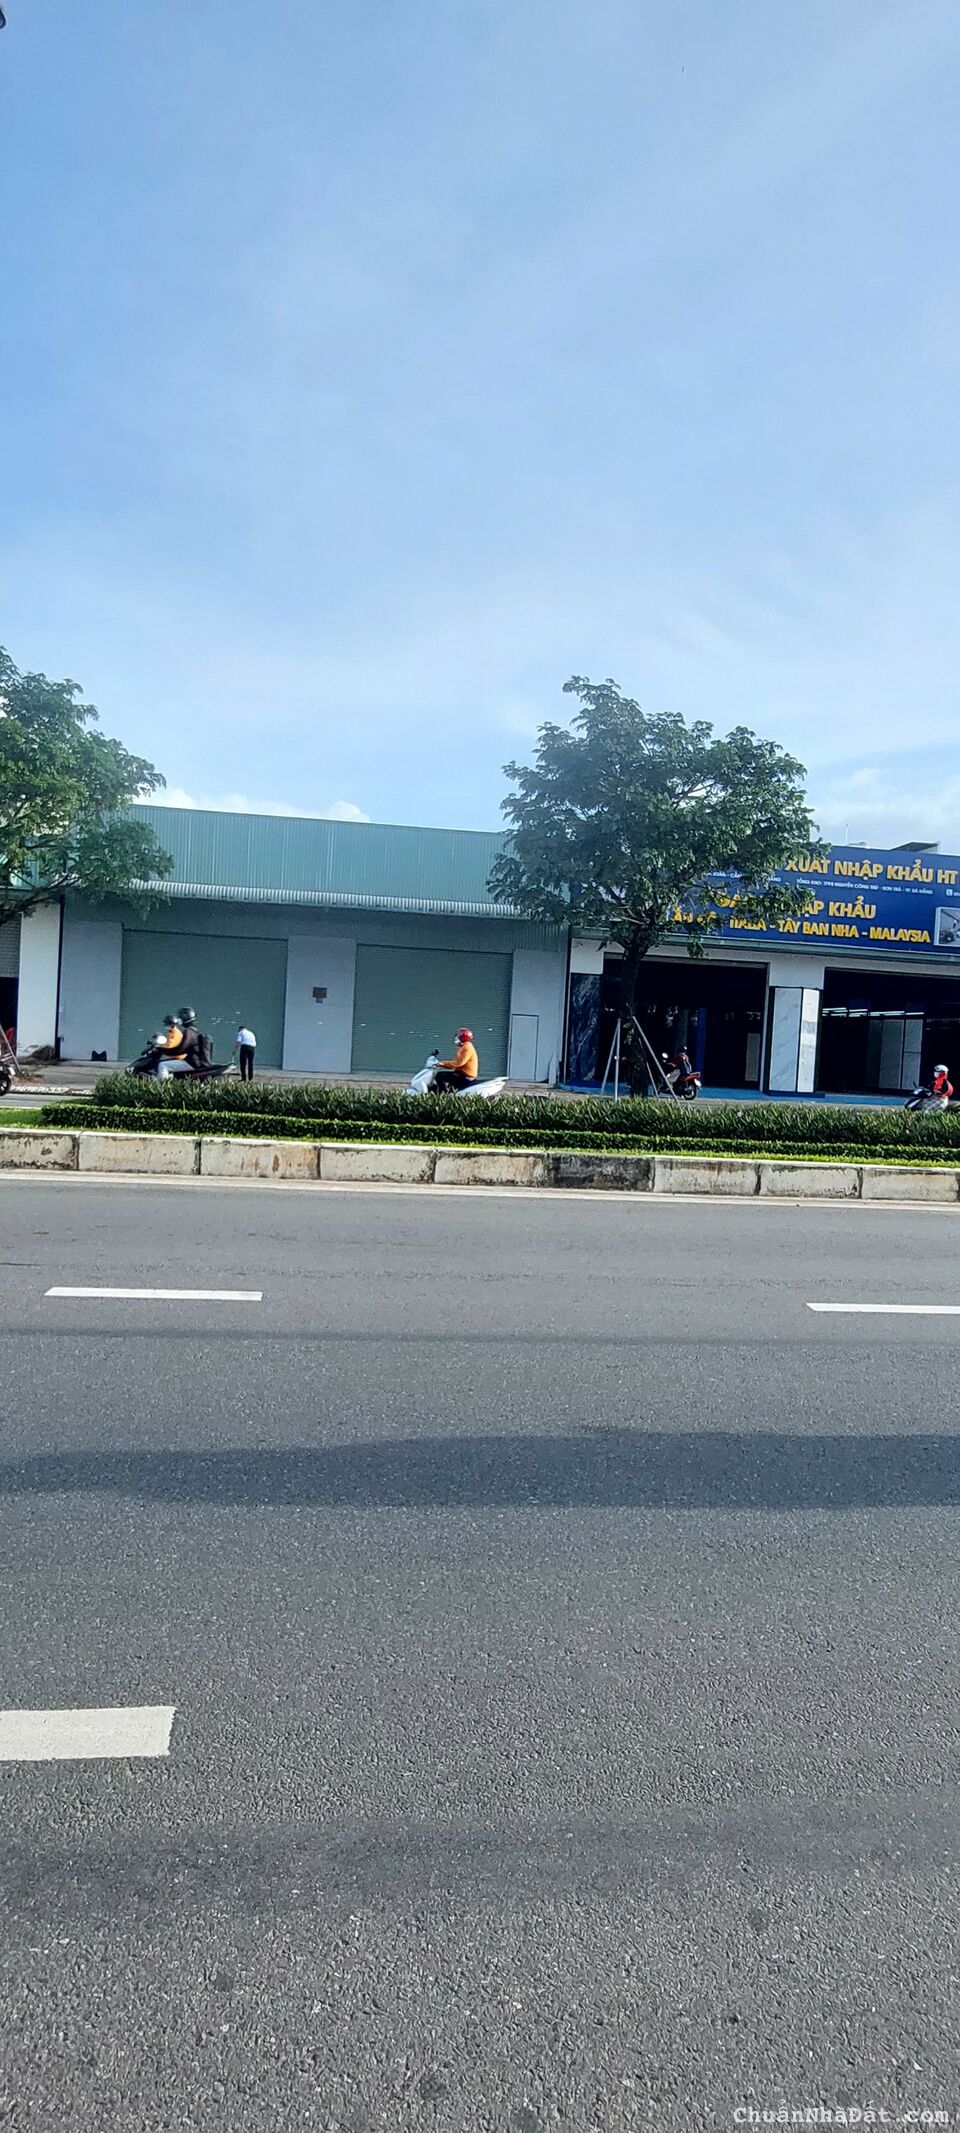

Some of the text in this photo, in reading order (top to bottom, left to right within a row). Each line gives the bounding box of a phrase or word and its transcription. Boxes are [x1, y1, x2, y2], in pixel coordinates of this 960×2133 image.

[834, 860, 883, 880] NHẬP
[886, 859, 933, 882] KHẨU
[937, 869, 958, 885] HT
[829, 895, 876, 919] KHẨU
[779, 917, 801, 934] TÂY
[802, 921, 829, 936] BAN
[831, 923, 859, 938] NHA
[869, 926, 931, 943] MALAYSIA
